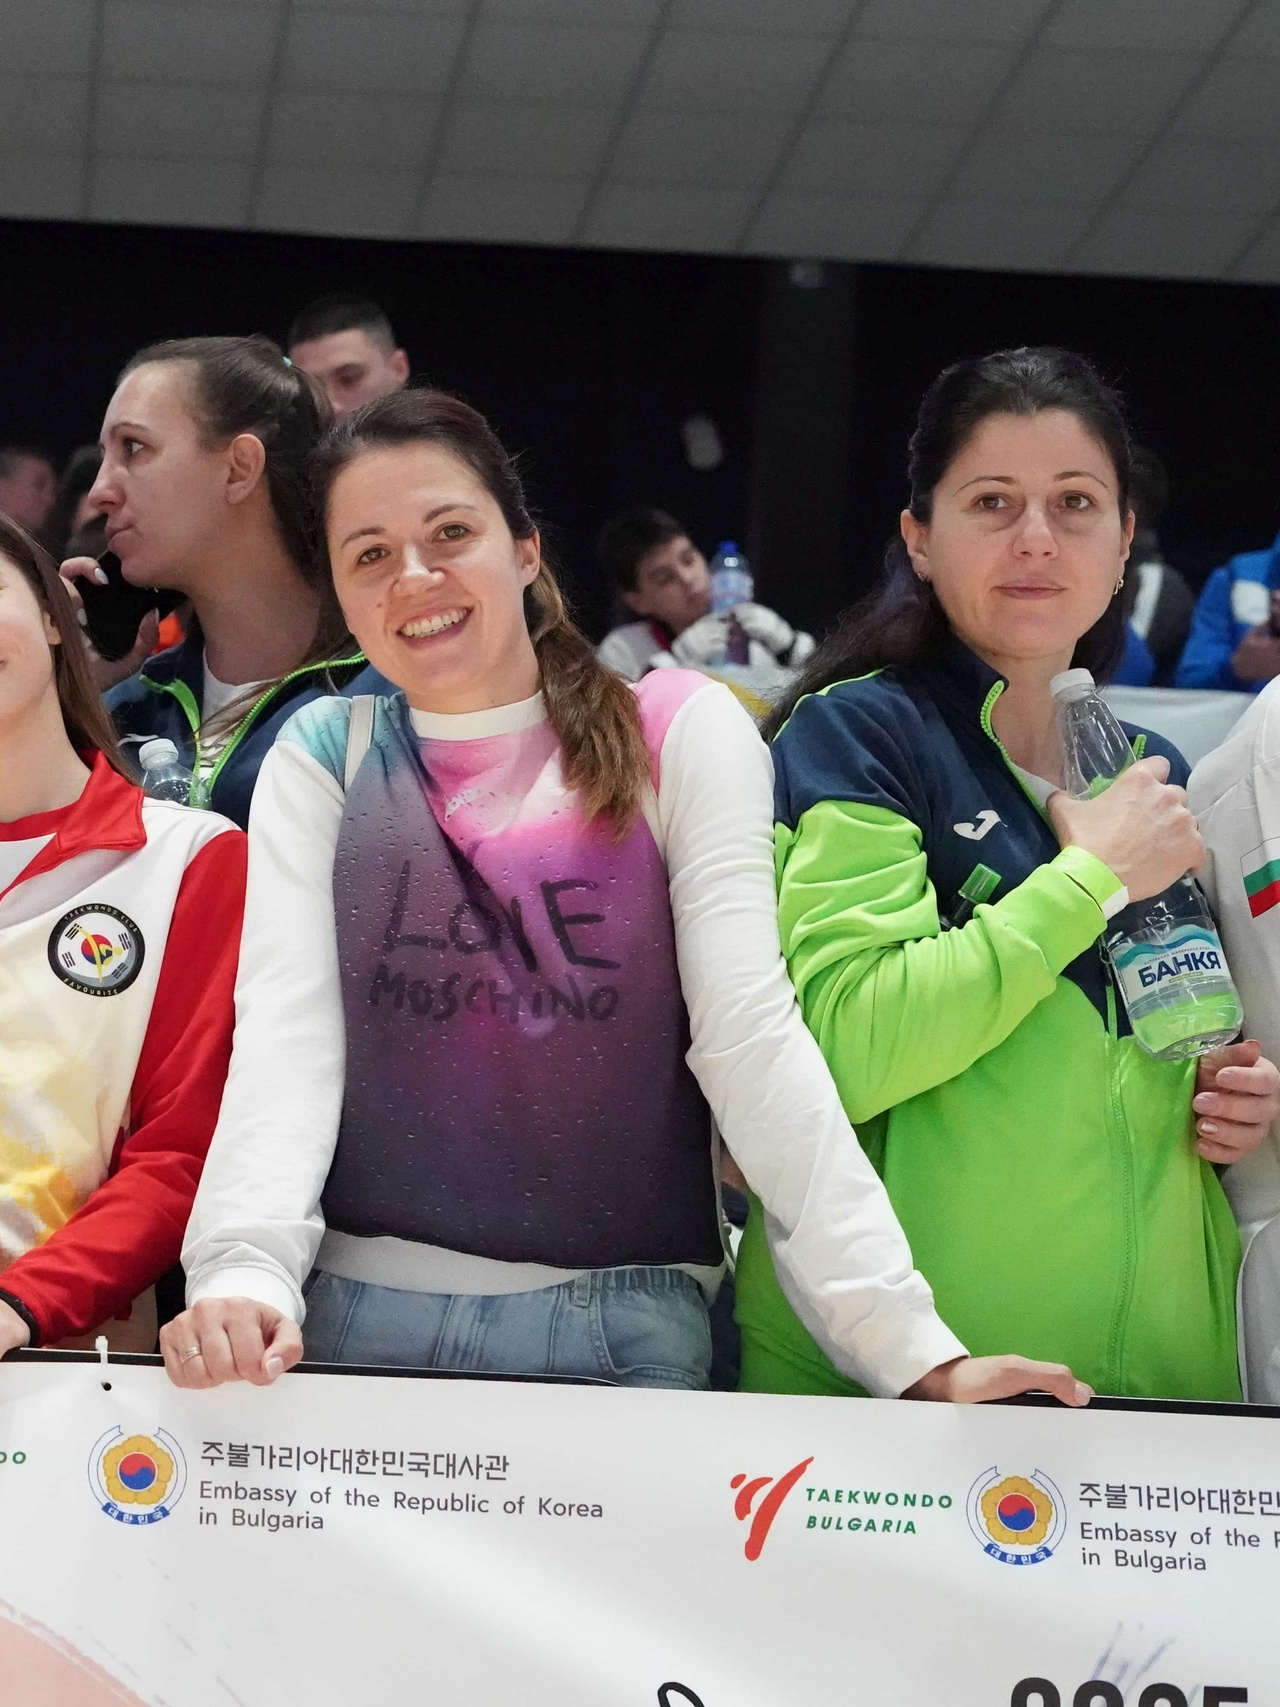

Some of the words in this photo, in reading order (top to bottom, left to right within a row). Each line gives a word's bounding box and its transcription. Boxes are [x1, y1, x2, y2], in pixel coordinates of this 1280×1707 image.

[63, 904, 118, 921] TAEKWONDO
[120, 914, 139, 933] CLUB
[1137, 950, 1222, 988] БАНКЯ
[63, 977, 119, 996] FAVOURITE
[368, 963, 619, 1025] MOSCHINO
[200, 1440, 510, 1482] 주불가리아대한민국대사관
[199, 1481, 298, 1507] Embassy
[310, 1486, 332, 1505] of
[345, 1488, 380, 1508] the
[393, 1491, 490, 1515] Republic
[503, 1497, 526, 1515] of
[538, 1497, 603, 1518] Korea
[805, 1487, 953, 1509] TAEKWONDO
[199, 1506, 218, 1526] in
[231, 1508, 325, 1533] Bulgaria
[805, 1515, 917, 1535] BULGARIA
[1079, 1521, 1178, 1549] Embassy
[1190, 1526, 1212, 1546] of
[1224, 1528, 1261, 1548] the
[1081, 1546, 1101, 1566] in
[1114, 1549, 1207, 1574] Bulgaria
